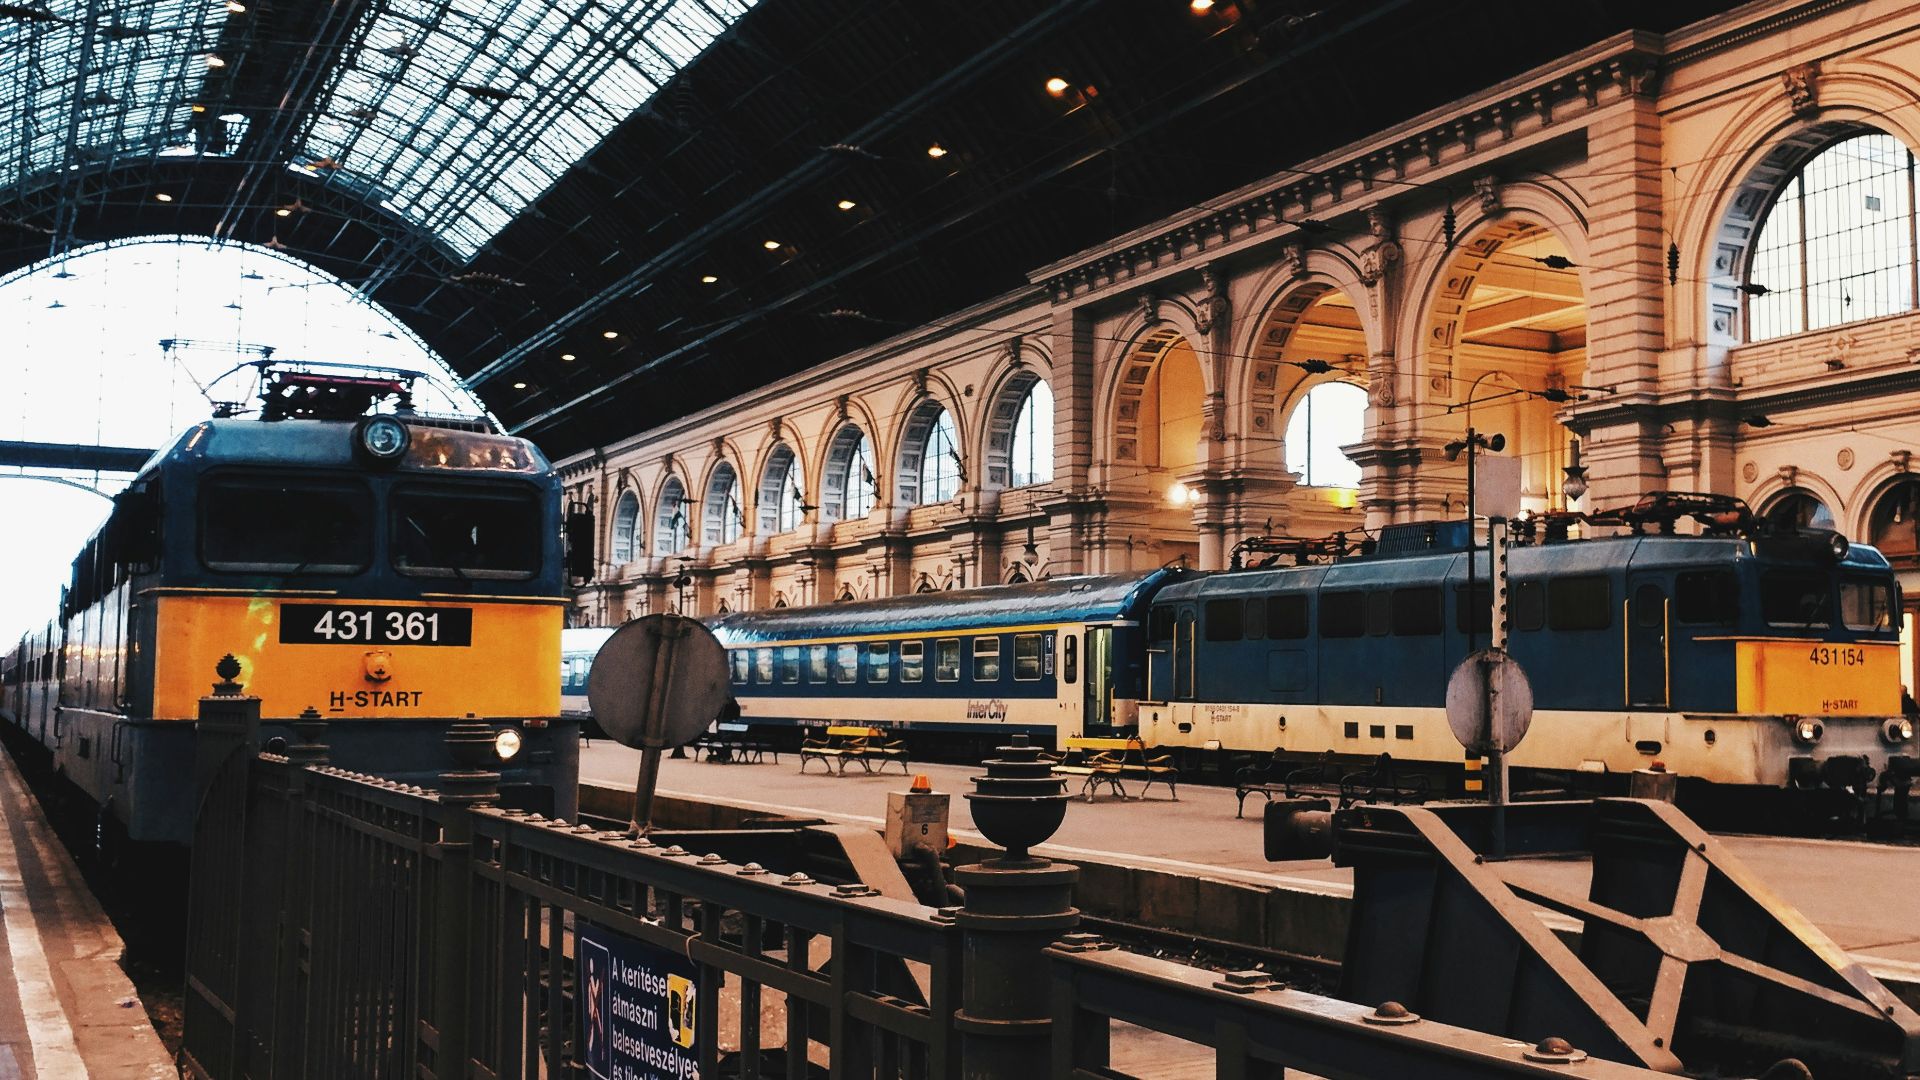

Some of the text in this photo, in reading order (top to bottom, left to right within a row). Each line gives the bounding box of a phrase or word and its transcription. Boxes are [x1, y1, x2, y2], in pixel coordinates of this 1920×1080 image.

[313, 610, 439, 642] 431 361
[329, 690, 423, 712] H-START
[966, 699, 1008, 723] InterCity
[1822, 699, 1858, 712] H-START
[921, 823, 929, 836] 6
[612, 956, 667, 998] A kerítése
[612, 990, 658, 1031] átmászni
